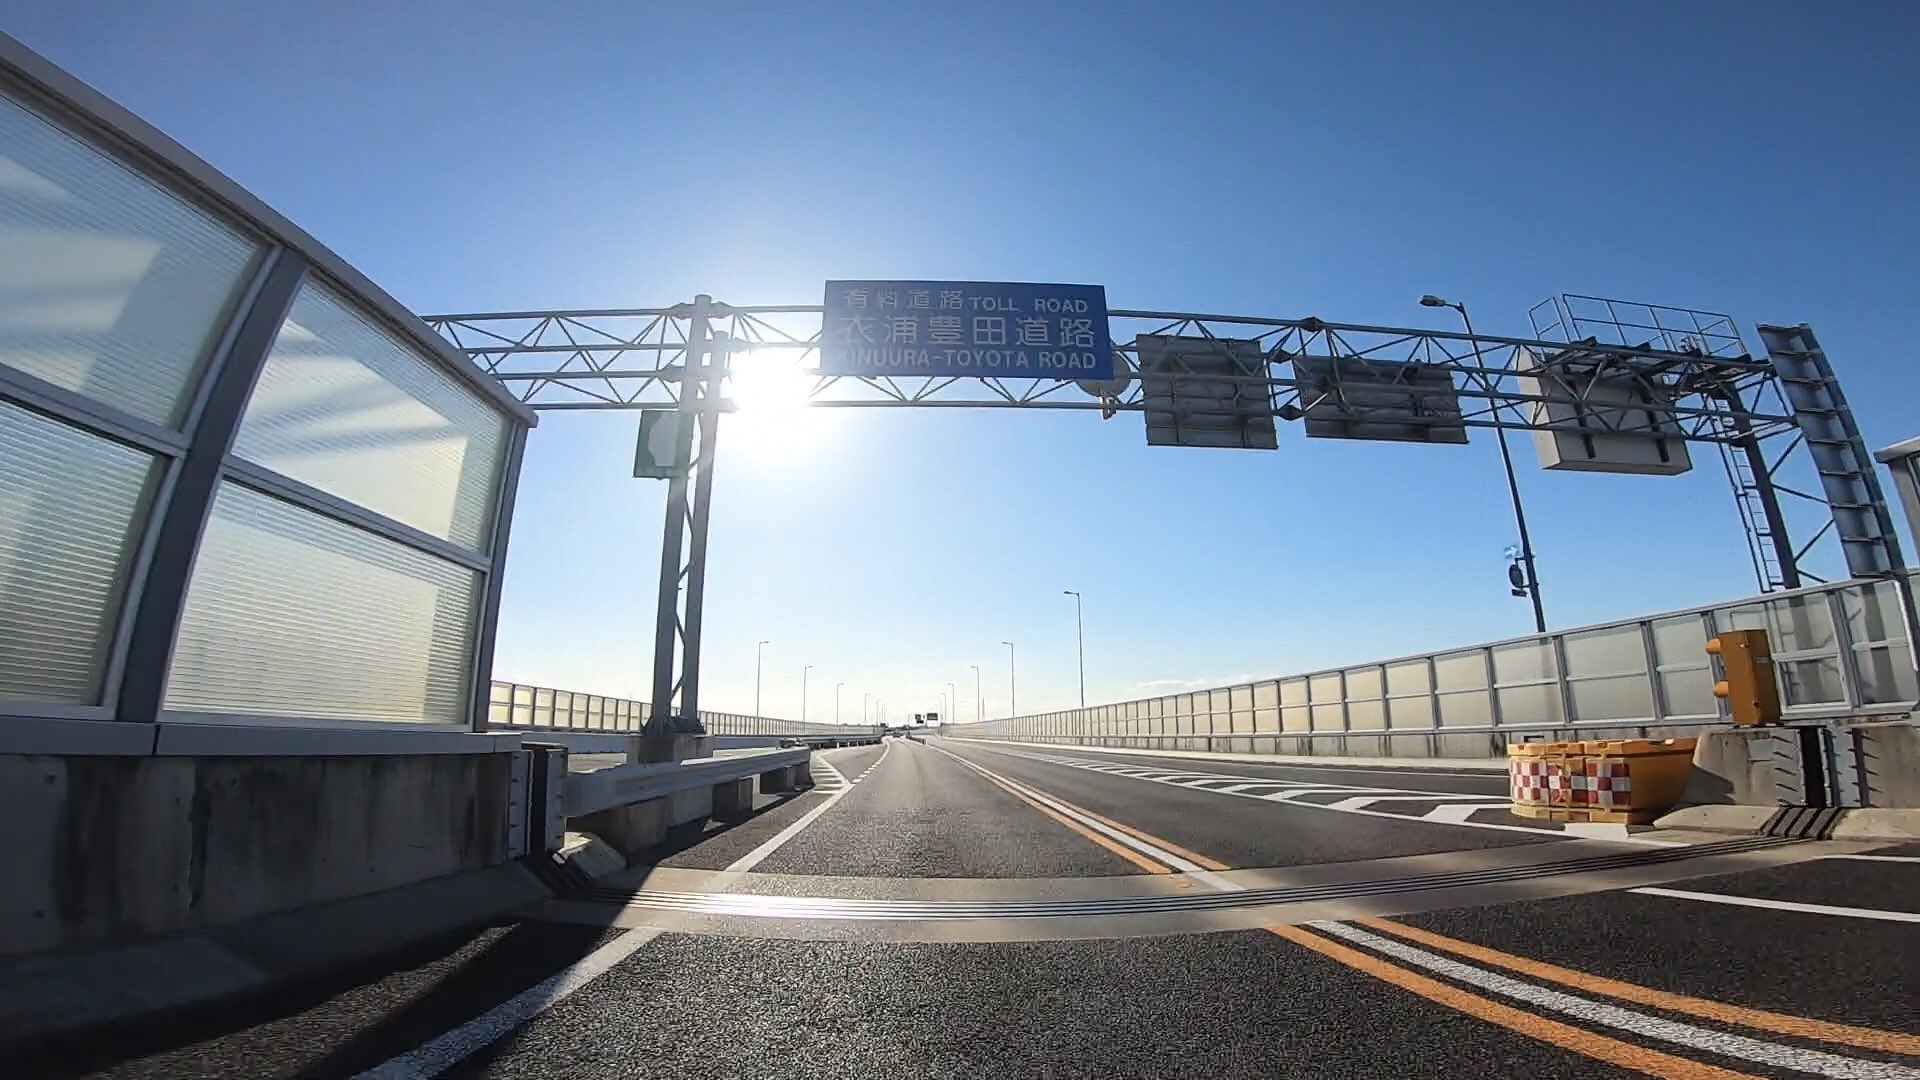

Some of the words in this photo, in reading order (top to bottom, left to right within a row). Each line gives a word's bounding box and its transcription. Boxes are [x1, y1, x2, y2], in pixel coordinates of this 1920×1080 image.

[840, 287, 963, 311] 有料道路
[967, 296, 1019, 312] TOLL
[1034, 296, 1089, 313] ROAD
[836, 313, 1096, 348] 衣浦豊田道路
[1039, 351, 1097, 370] ROAD
